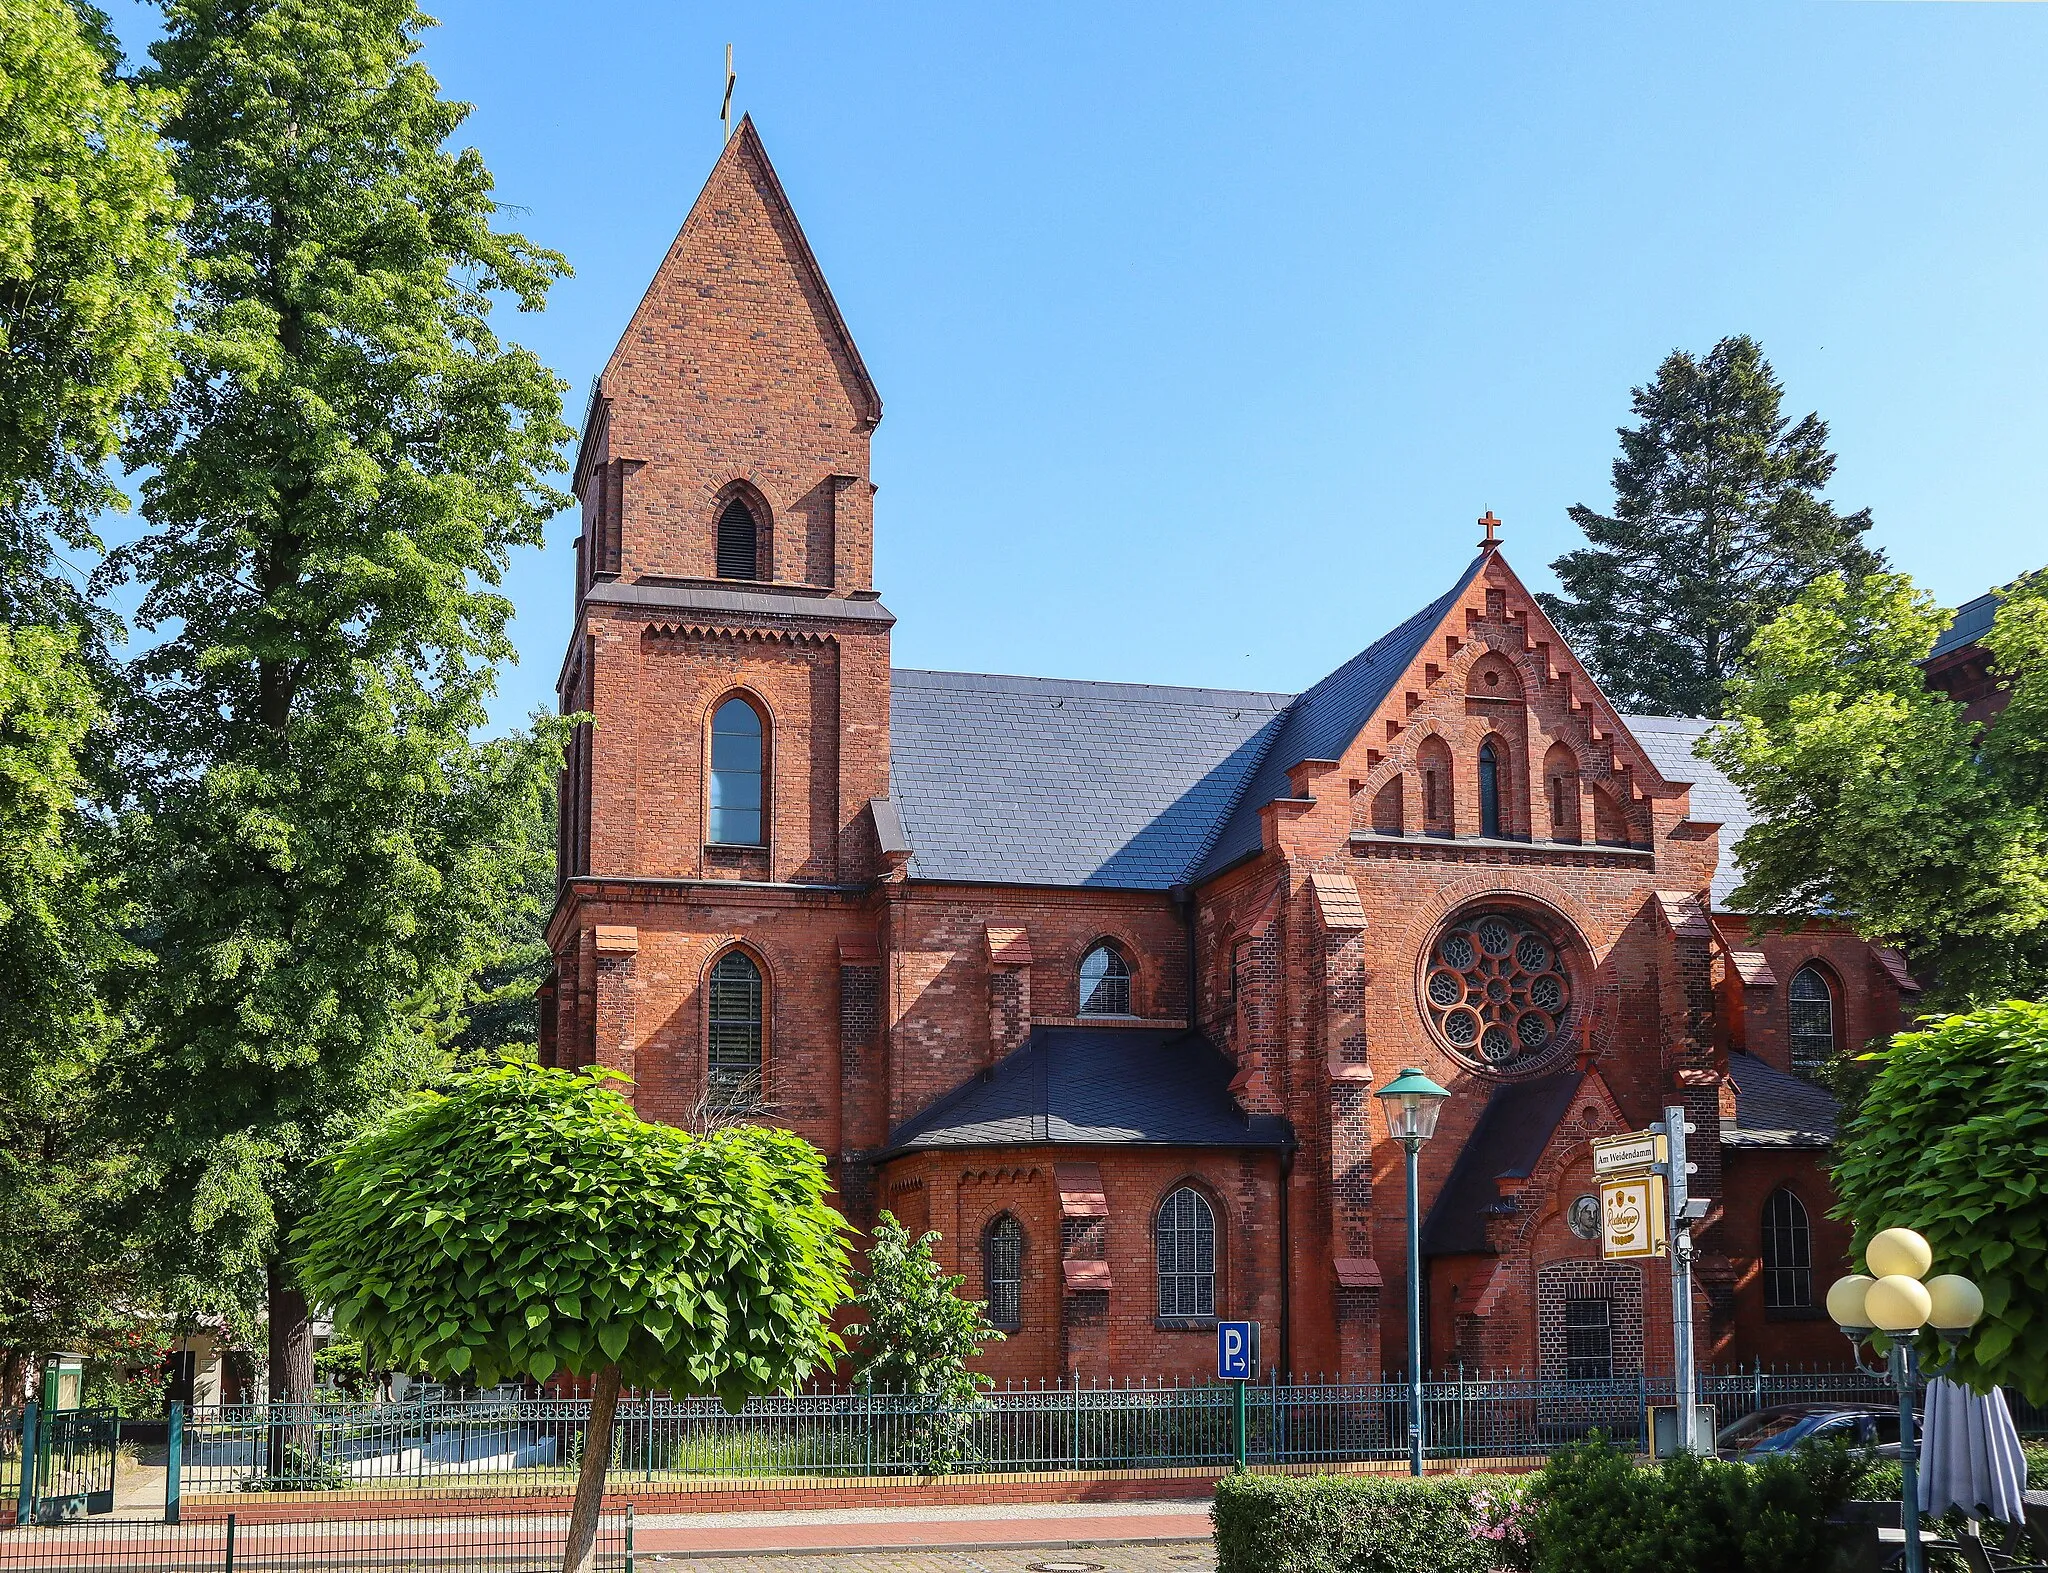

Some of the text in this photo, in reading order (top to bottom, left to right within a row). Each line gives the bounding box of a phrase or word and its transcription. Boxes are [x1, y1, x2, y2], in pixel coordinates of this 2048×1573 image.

[1598, 1149, 1652, 1164] Am Weidendamm
[1225, 1329, 1242, 1371] P
